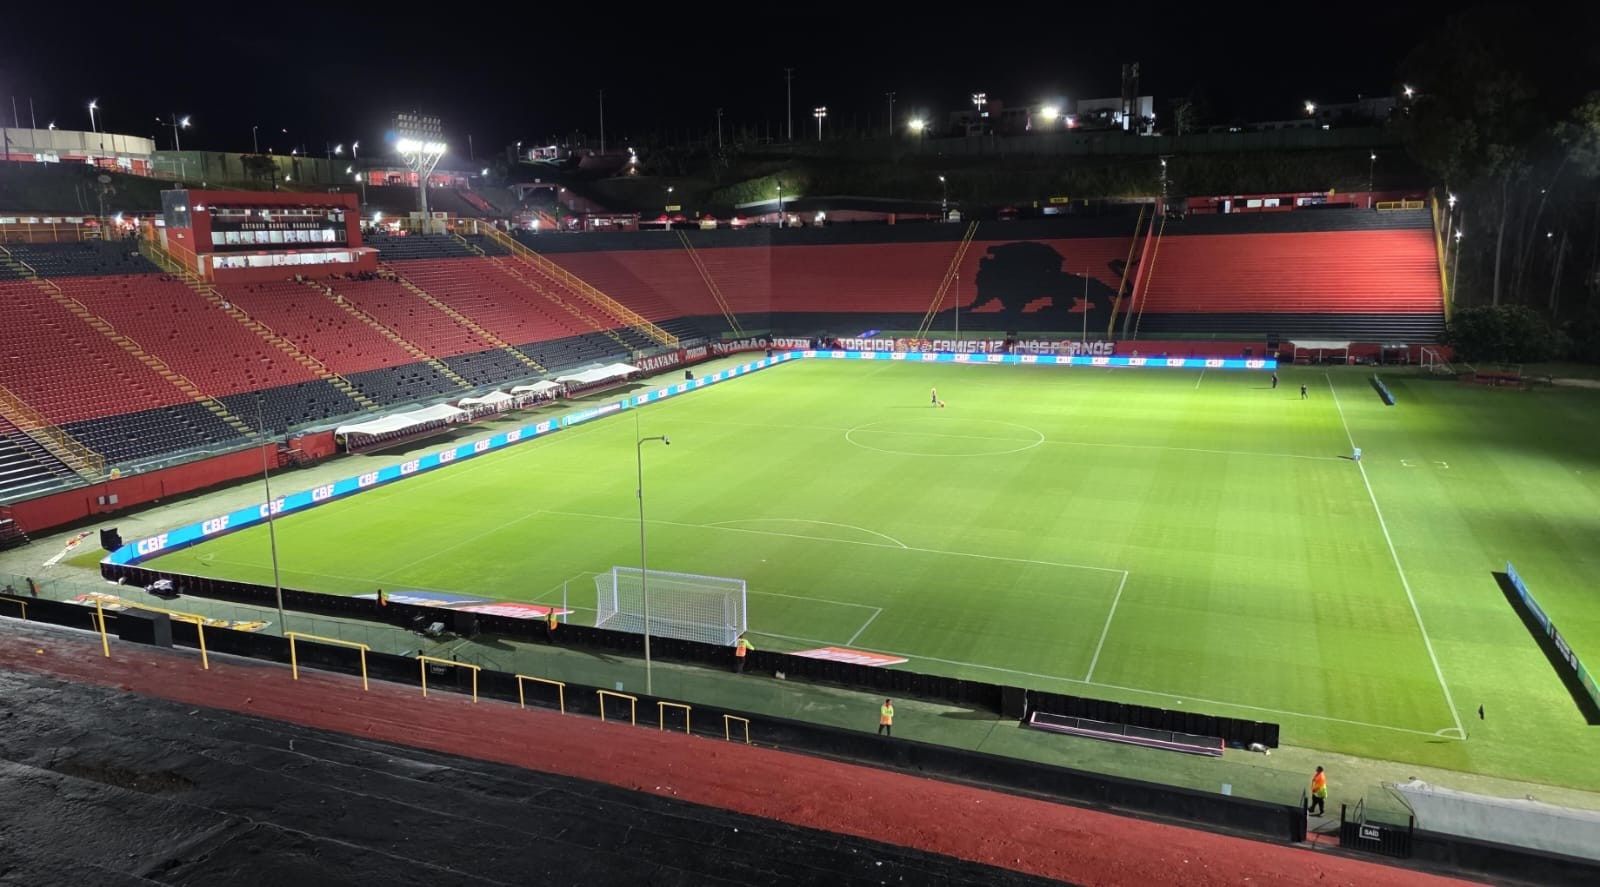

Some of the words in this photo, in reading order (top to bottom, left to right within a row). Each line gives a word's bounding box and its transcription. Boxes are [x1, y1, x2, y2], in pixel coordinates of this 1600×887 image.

[838, 338, 894, 351] TORCIDA
[933, 339, 985, 353] CAMISA
[636, 352, 679, 372] CARAVANA
[440, 448, 457, 462] CBF
[400, 460, 419, 474] CBF
[358, 471, 379, 488] CBF
[312, 484, 335, 502] CBF
[260, 498, 285, 517] CBF
[202, 516, 230, 535] CBF
[137, 534, 169, 556] CBF
